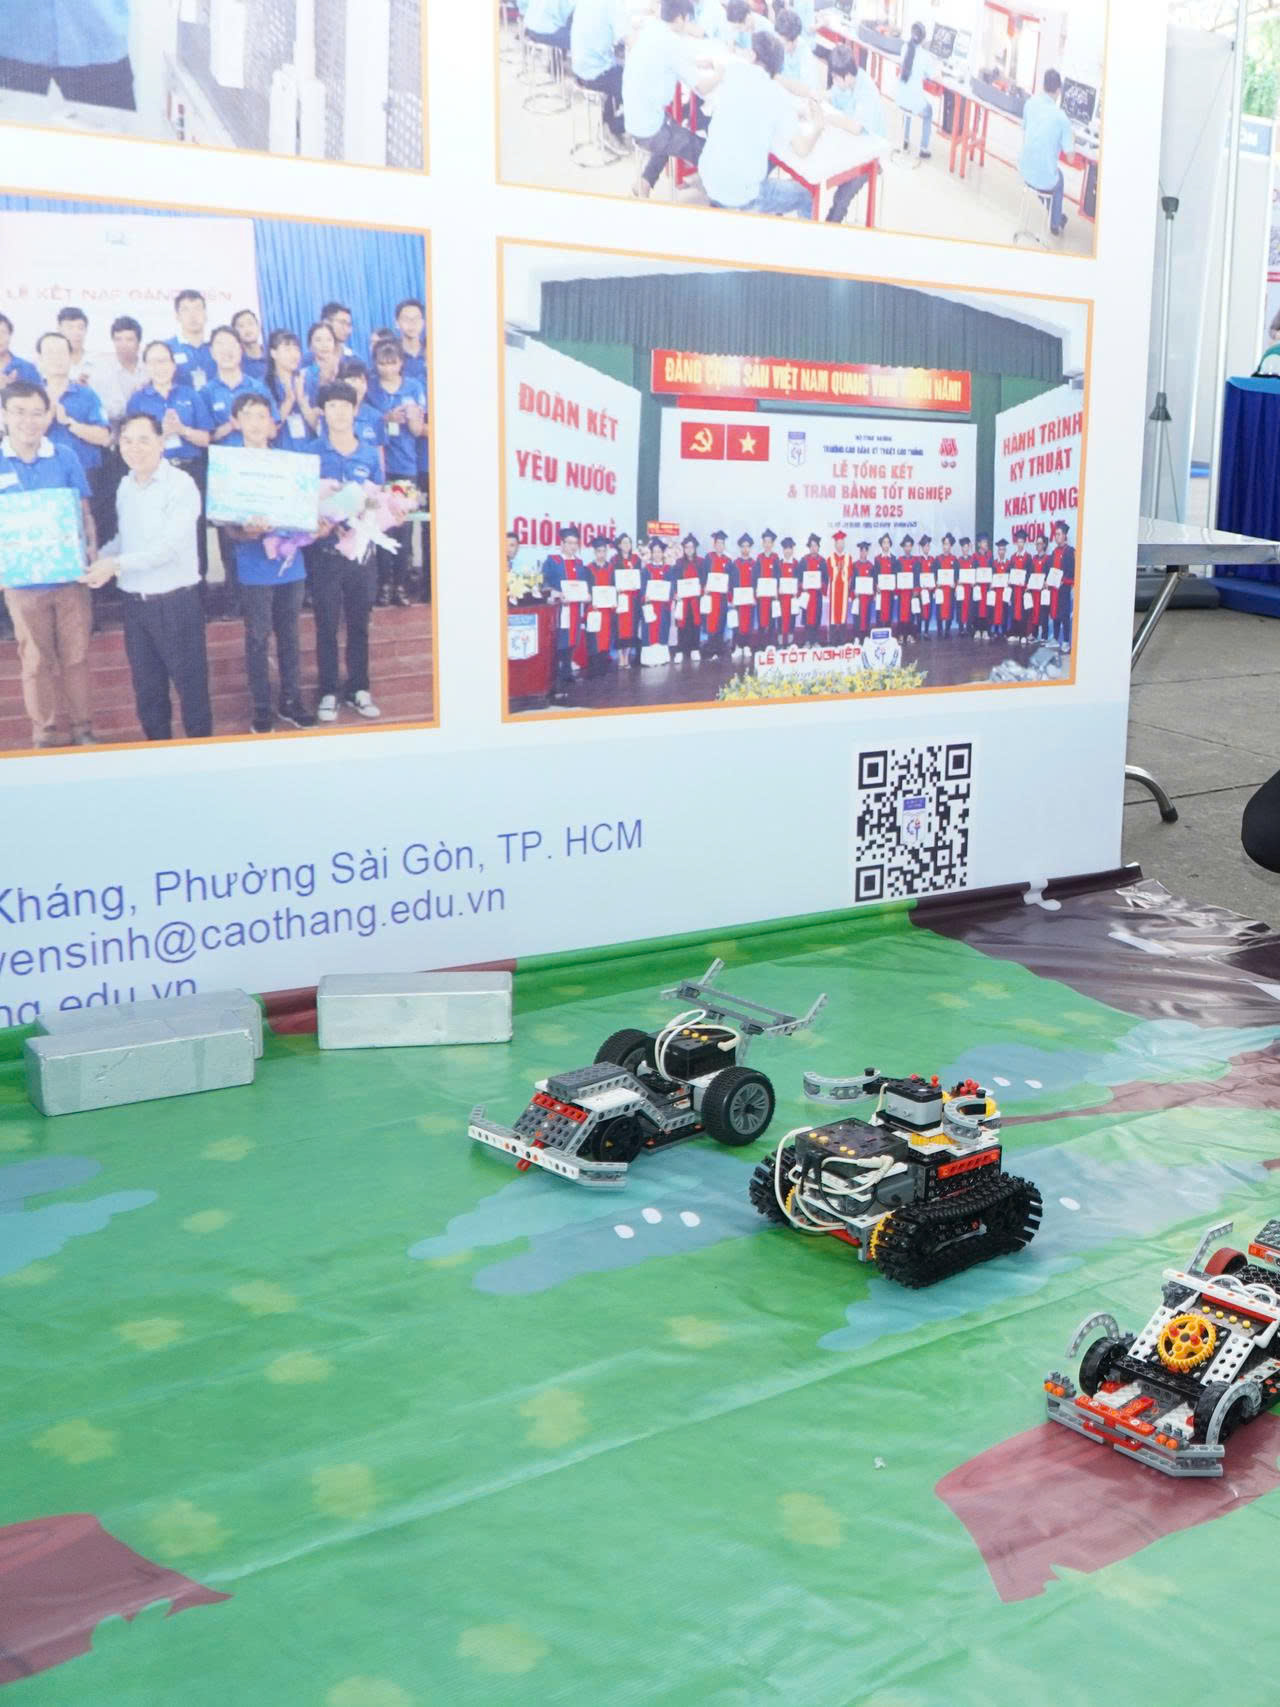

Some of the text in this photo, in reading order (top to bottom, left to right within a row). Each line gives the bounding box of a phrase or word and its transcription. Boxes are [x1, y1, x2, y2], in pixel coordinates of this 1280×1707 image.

[665, 352, 702, 384] ĐẢNG
[772, 363, 799, 393] VIỆT
[800, 367, 829, 393] NAM
[831, 370, 869, 396] QUANG
[519, 382, 619, 442] ĐOÀN KẾT
[1003, 411, 1083, 457] HÀNH TRÌNH
[516, 449, 617, 496] YÊU NƯỚC
[890, 460, 914, 480] KẾT
[1029, 446, 1072, 478] THUẬT
[882, 481, 903, 500] TỐT
[908, 484, 953, 503] NGHIỆP
[1039, 486, 1079, 516] VỌNG
[843, 503, 904, 518] NĂM 2025
[780, 648, 807, 664] TỐT
[155, 861, 317, 907] Phường
[331, 848, 388, 884] Sài
[402, 842, 486, 877] Gòn,
[497, 830, 552, 865] TP.
[566, 819, 644, 857] HCM
